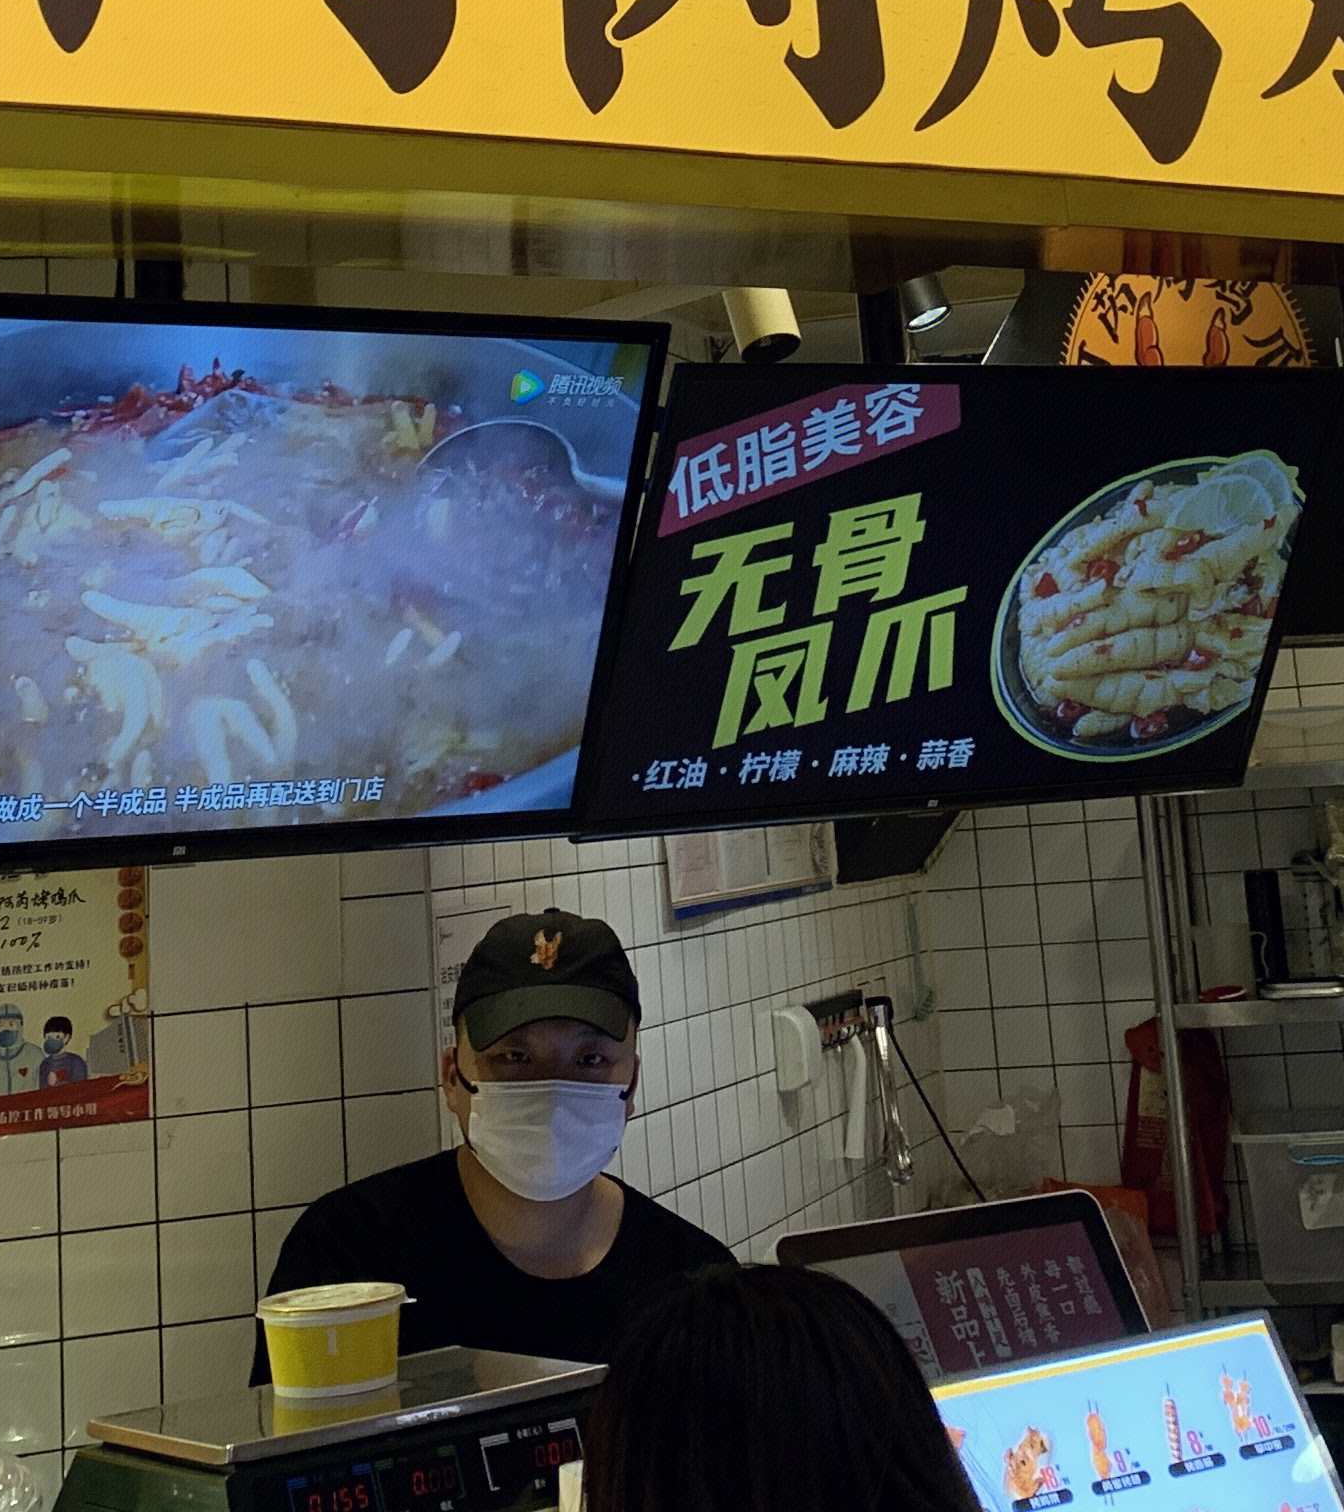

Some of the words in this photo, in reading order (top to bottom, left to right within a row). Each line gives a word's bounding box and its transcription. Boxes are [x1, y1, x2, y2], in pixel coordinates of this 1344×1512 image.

[548, 374, 624, 396] 腾讯视频
[548, 396, 615, 408] 不负好时光
[668, 384, 923, 518] 低脂美容
[668, 492, 926, 651] 无骨
[711, 585, 969, 750] 凤爪
[174, 775, 386, 813] 半成品再配送到门店
[0, 915, 10, 931] 2
[0, 932, 42, 952] 100%
[1044, 1259, 1076, 1316] 每一口
